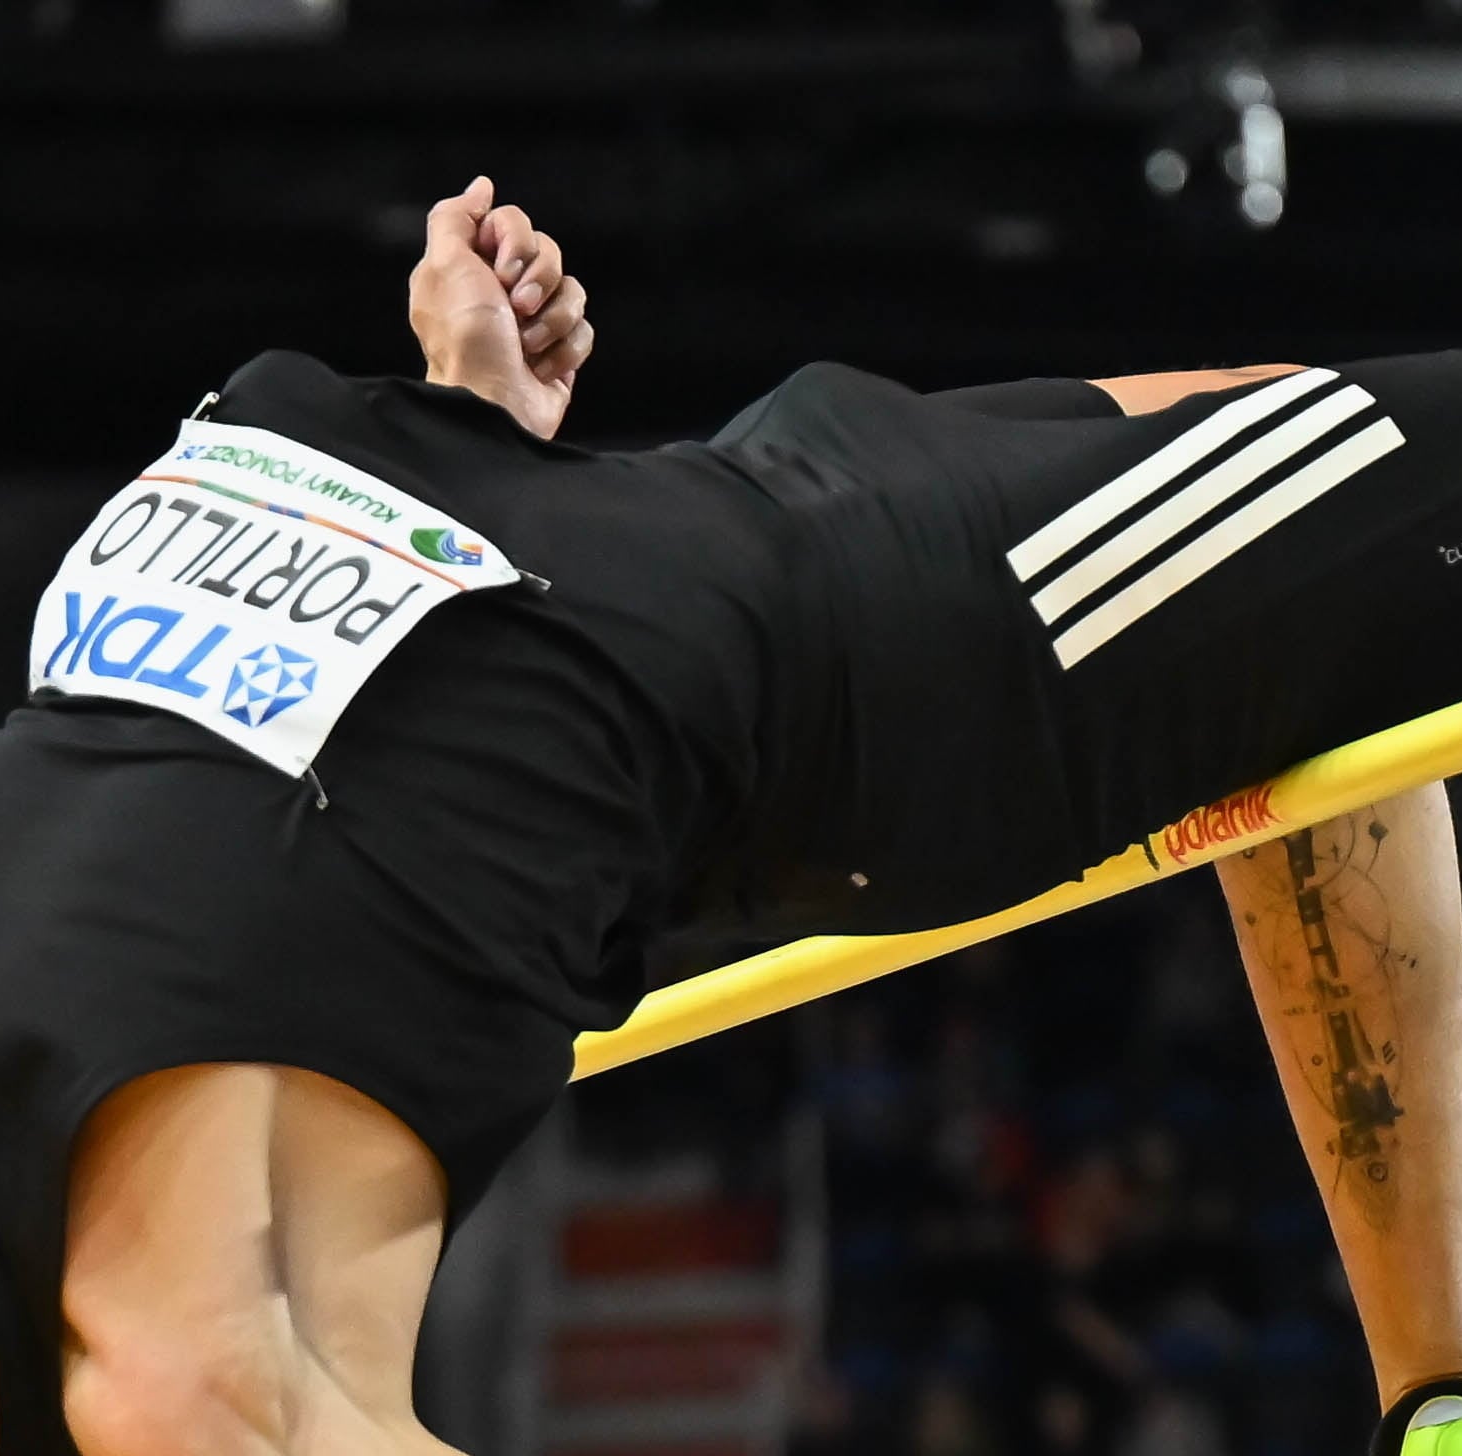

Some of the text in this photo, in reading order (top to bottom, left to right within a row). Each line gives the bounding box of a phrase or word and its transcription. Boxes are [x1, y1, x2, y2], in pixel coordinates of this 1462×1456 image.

[301, 473, 402, 523] KUJAWY
[90, 491, 425, 646] PORTILLO
[43, 590, 232, 699] TDK
